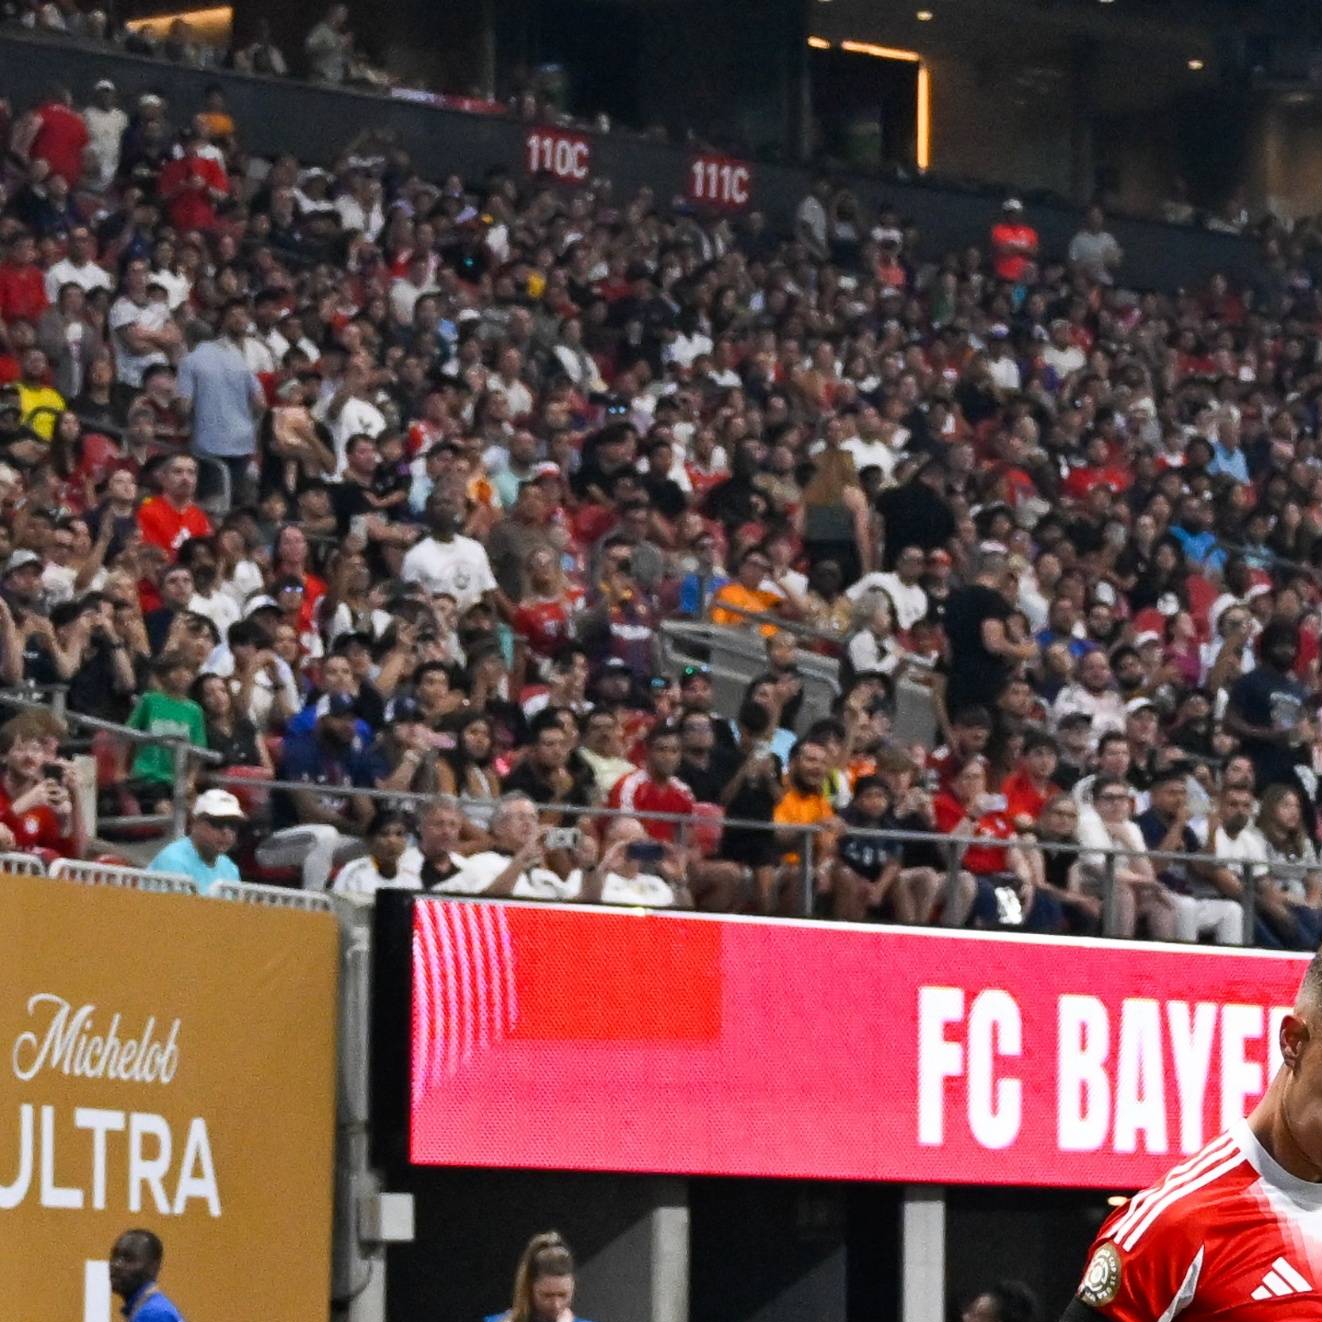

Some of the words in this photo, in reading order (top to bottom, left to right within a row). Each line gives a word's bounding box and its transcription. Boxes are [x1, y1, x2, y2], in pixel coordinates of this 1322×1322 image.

[527, 134, 589, 179] 110C
[691, 160, 750, 204] 111C
[12, 992, 181, 1085] Michelob
[917, 986, 1022, 1150] FC
[1057, 994, 1296, 1156] BAYE
